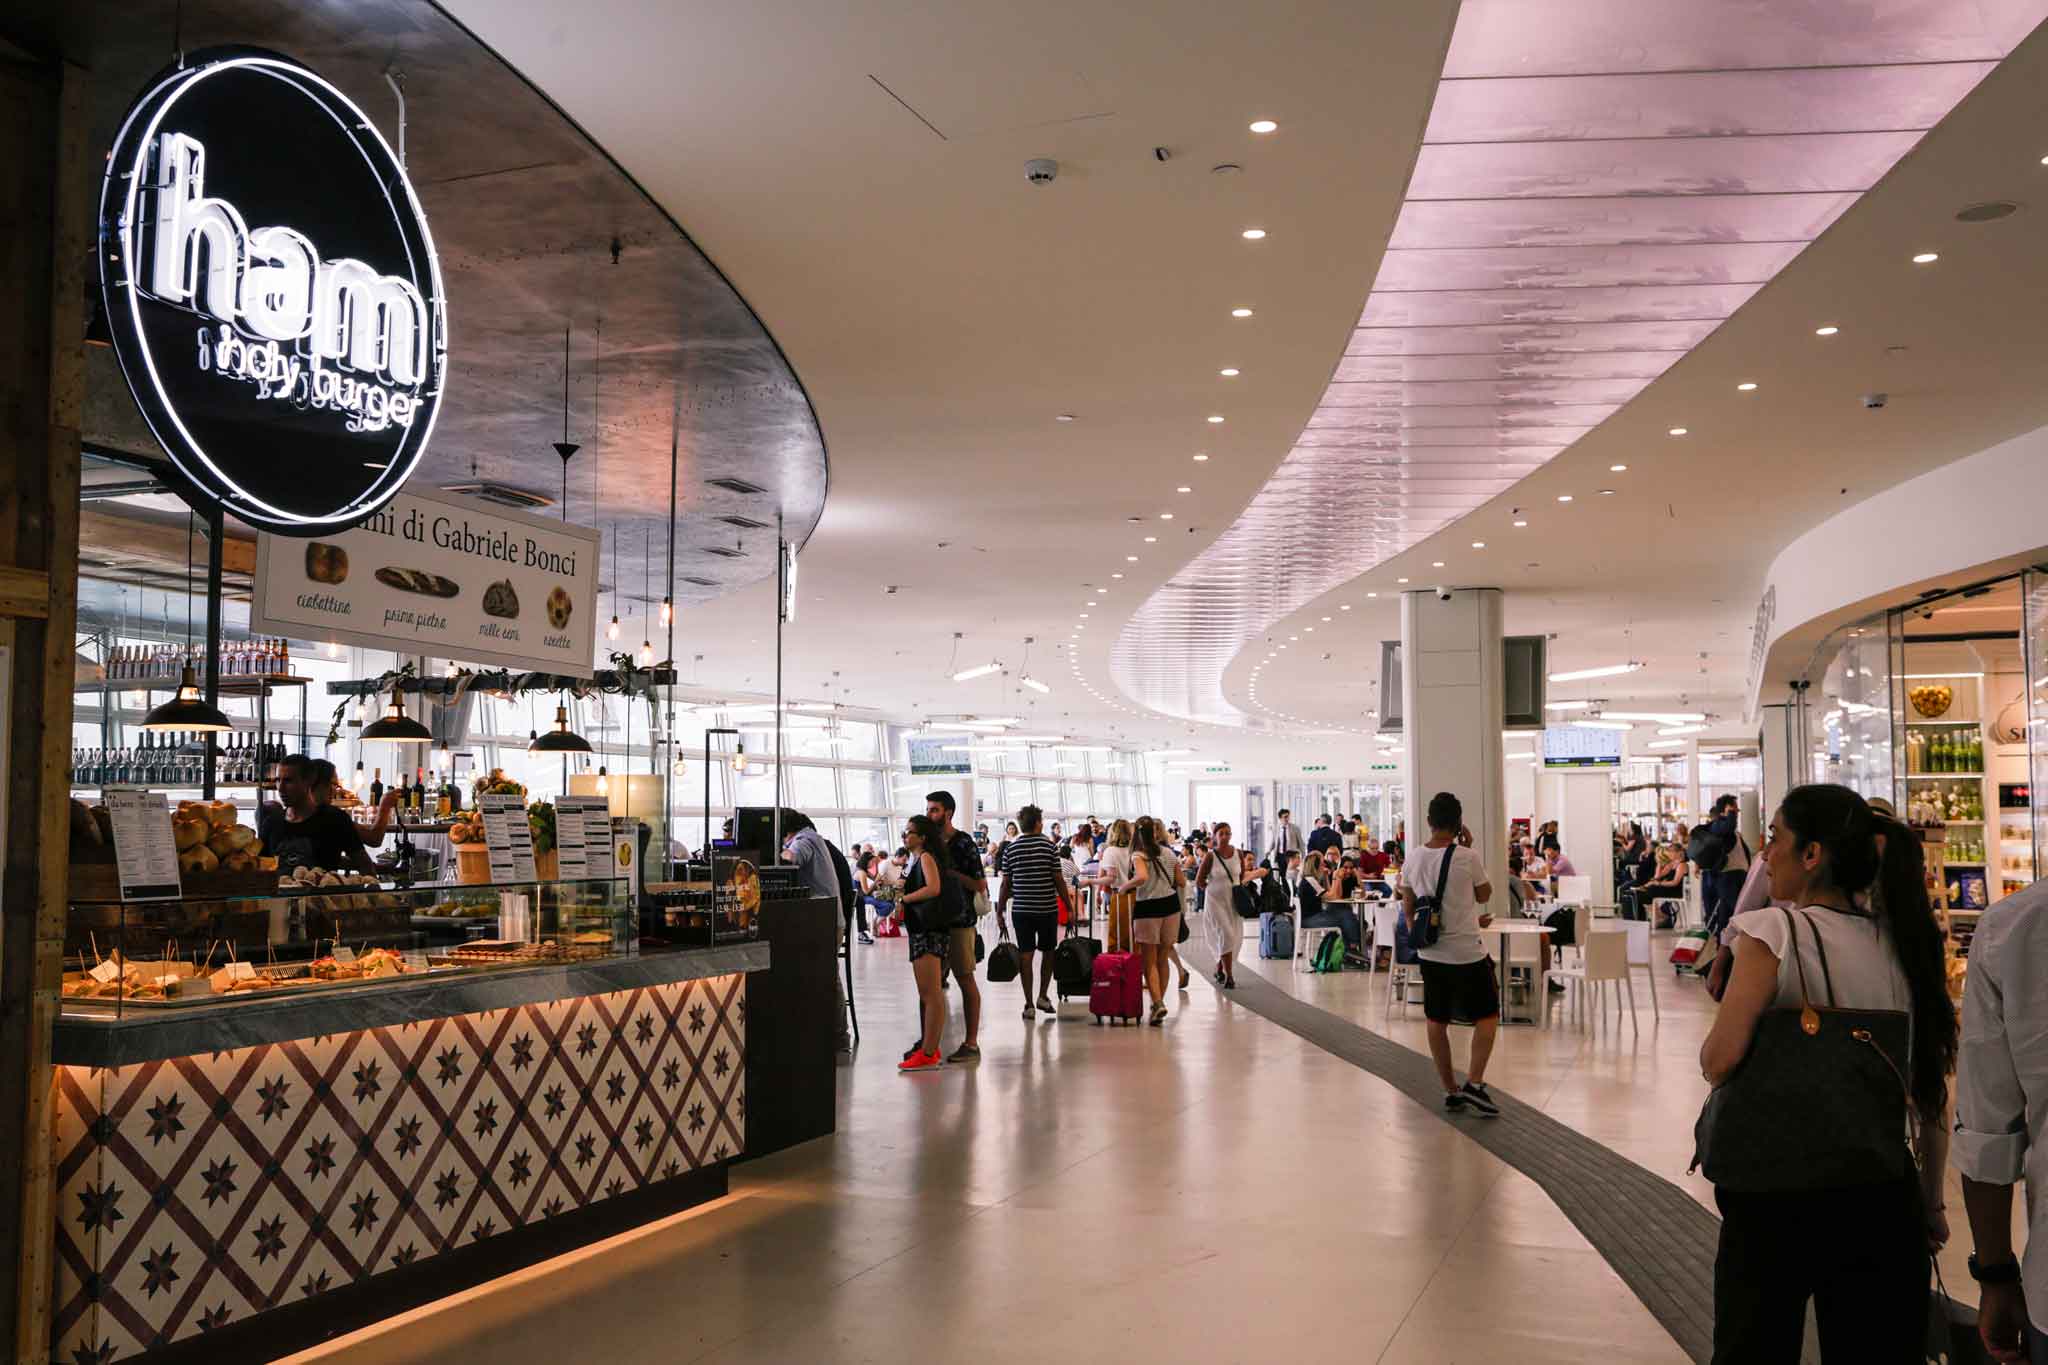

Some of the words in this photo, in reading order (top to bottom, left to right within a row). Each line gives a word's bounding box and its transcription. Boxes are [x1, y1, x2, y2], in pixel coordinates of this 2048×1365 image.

[153, 131, 428, 386] ham
[214, 324, 301, 399] holy
[311, 352, 424, 431] burger
[403, 509, 425, 542] di
[433, 517, 518, 564] Gabriele
[525, 539, 577, 577] Bonci
[296, 593, 352, 615] ciabattina
